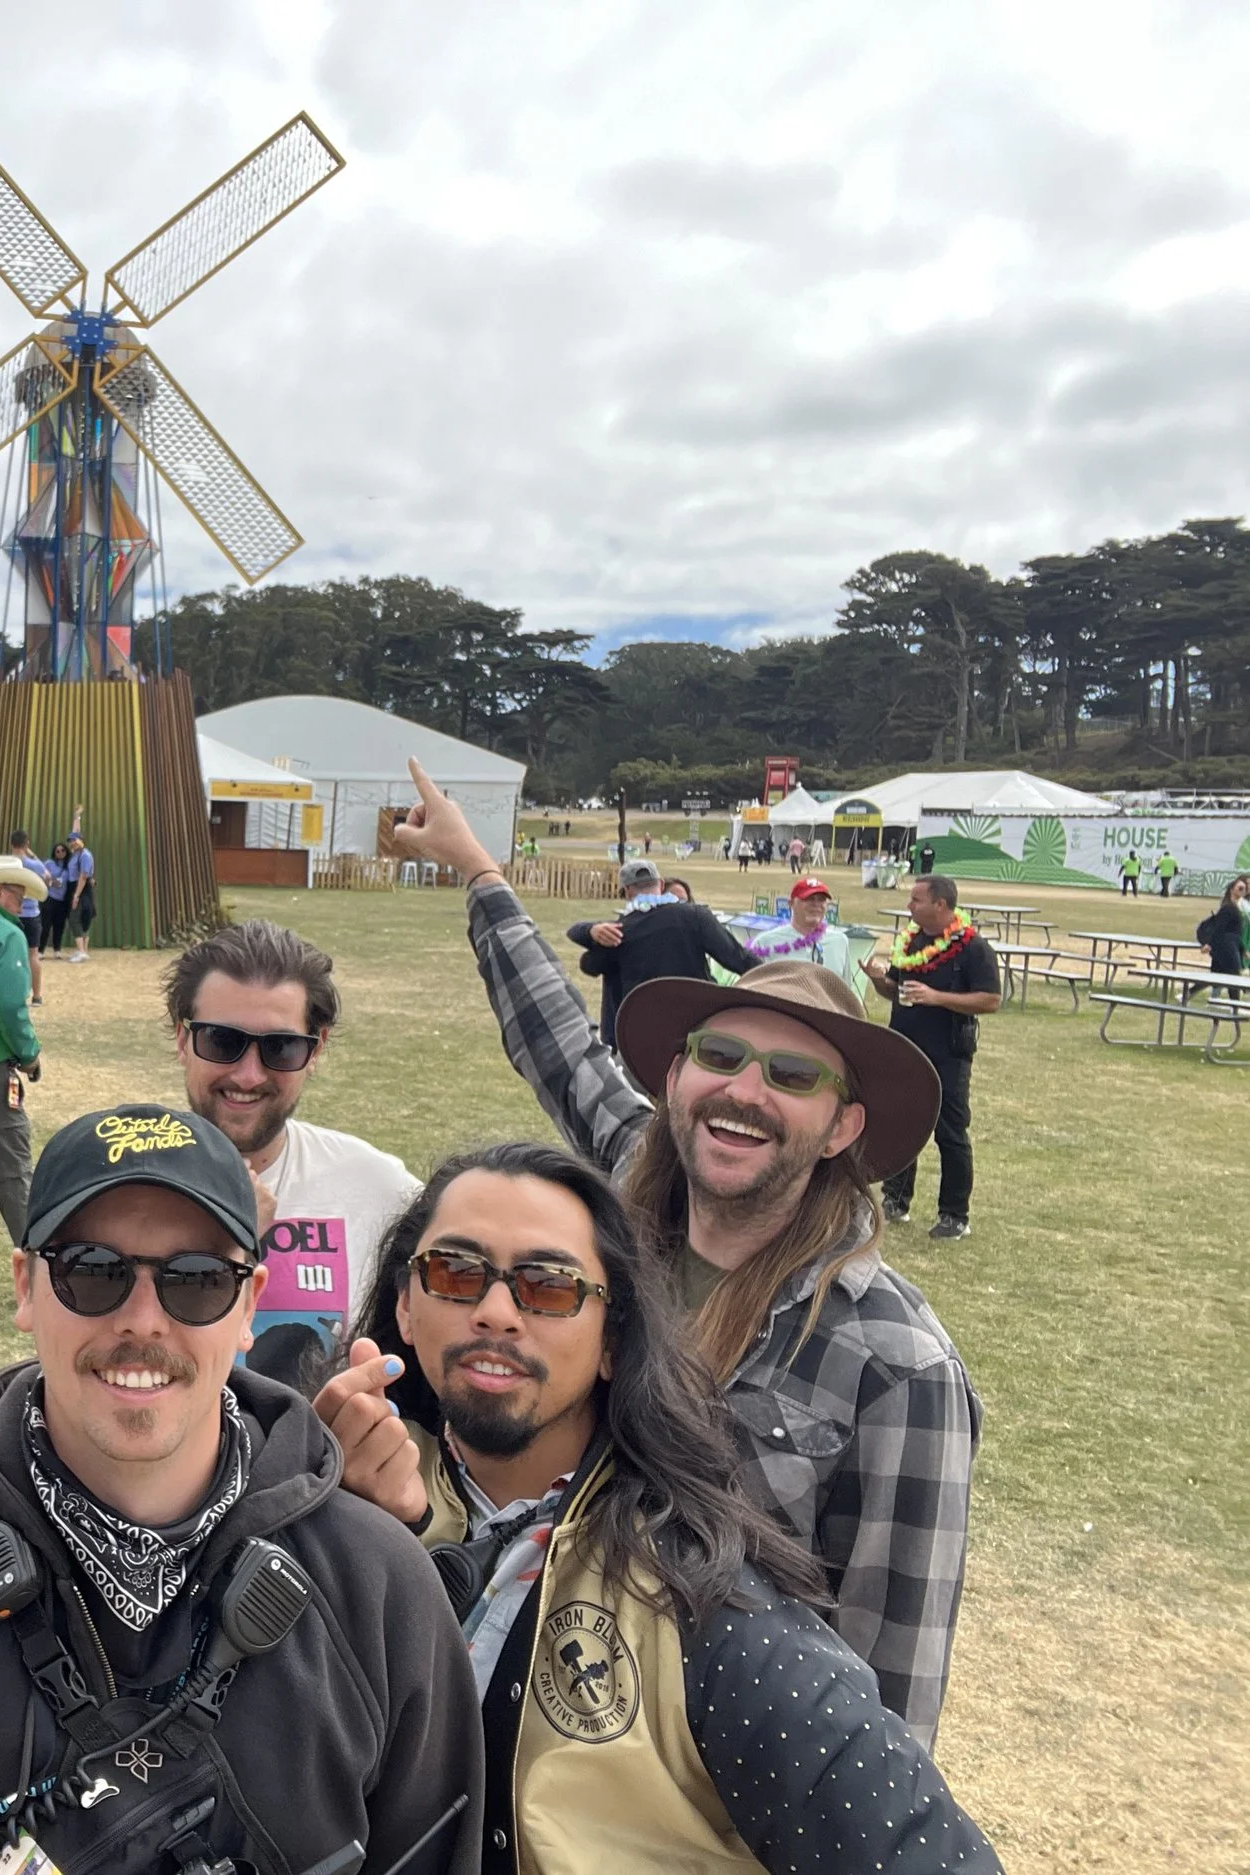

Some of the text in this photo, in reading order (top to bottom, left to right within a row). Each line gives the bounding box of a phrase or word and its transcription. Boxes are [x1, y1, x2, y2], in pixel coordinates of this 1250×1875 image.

[1102, 827, 1169, 850] HOUSE
[95, 1113, 192, 1139] Outside
[106, 1131, 197, 1164] Lands
[280, 1568, 307, 1595] MOTOROLA
[548, 1608, 585, 1636] IRON
[539, 1672, 628, 1734] CREATIVE PRODUCTION
